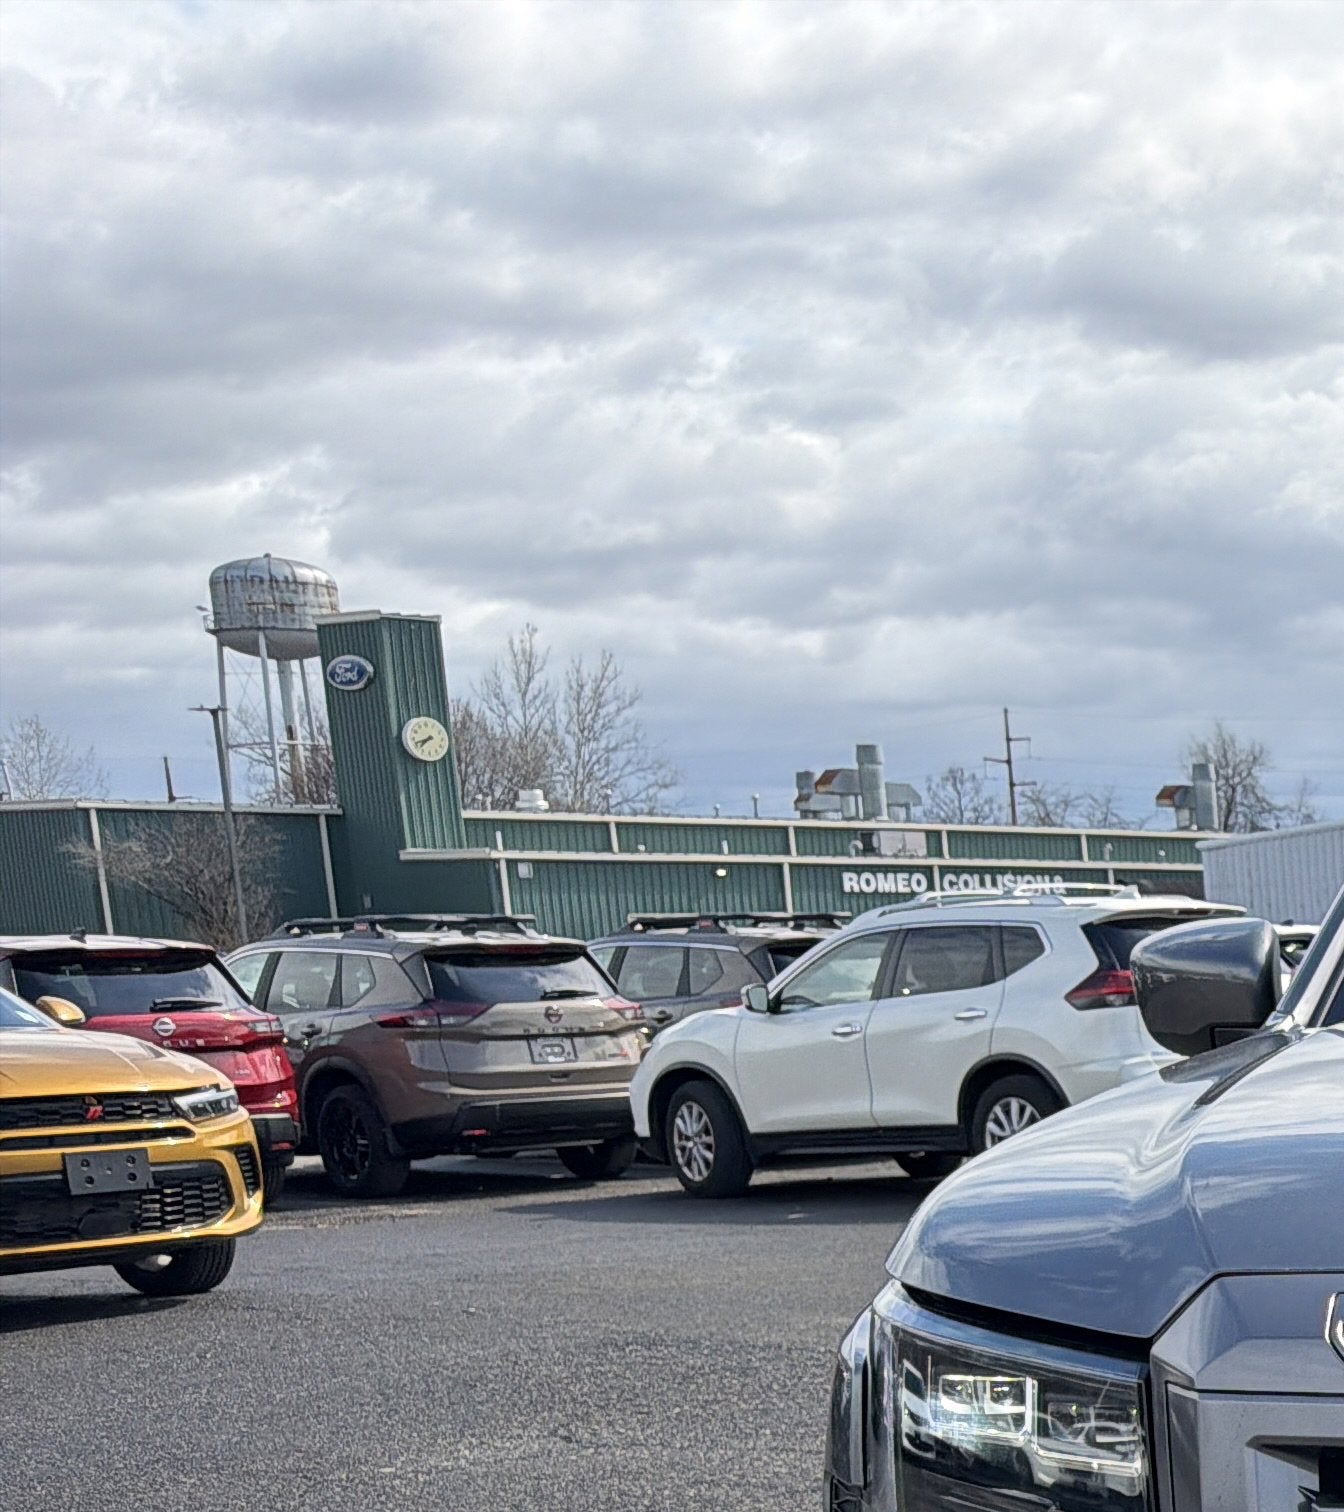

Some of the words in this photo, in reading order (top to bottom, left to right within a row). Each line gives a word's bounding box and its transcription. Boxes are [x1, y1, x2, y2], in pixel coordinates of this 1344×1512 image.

[335, 663, 358, 682] Ford
[842, 872, 928, 893] ROMEO
[942, 873, 1051, 895] COLLISION
